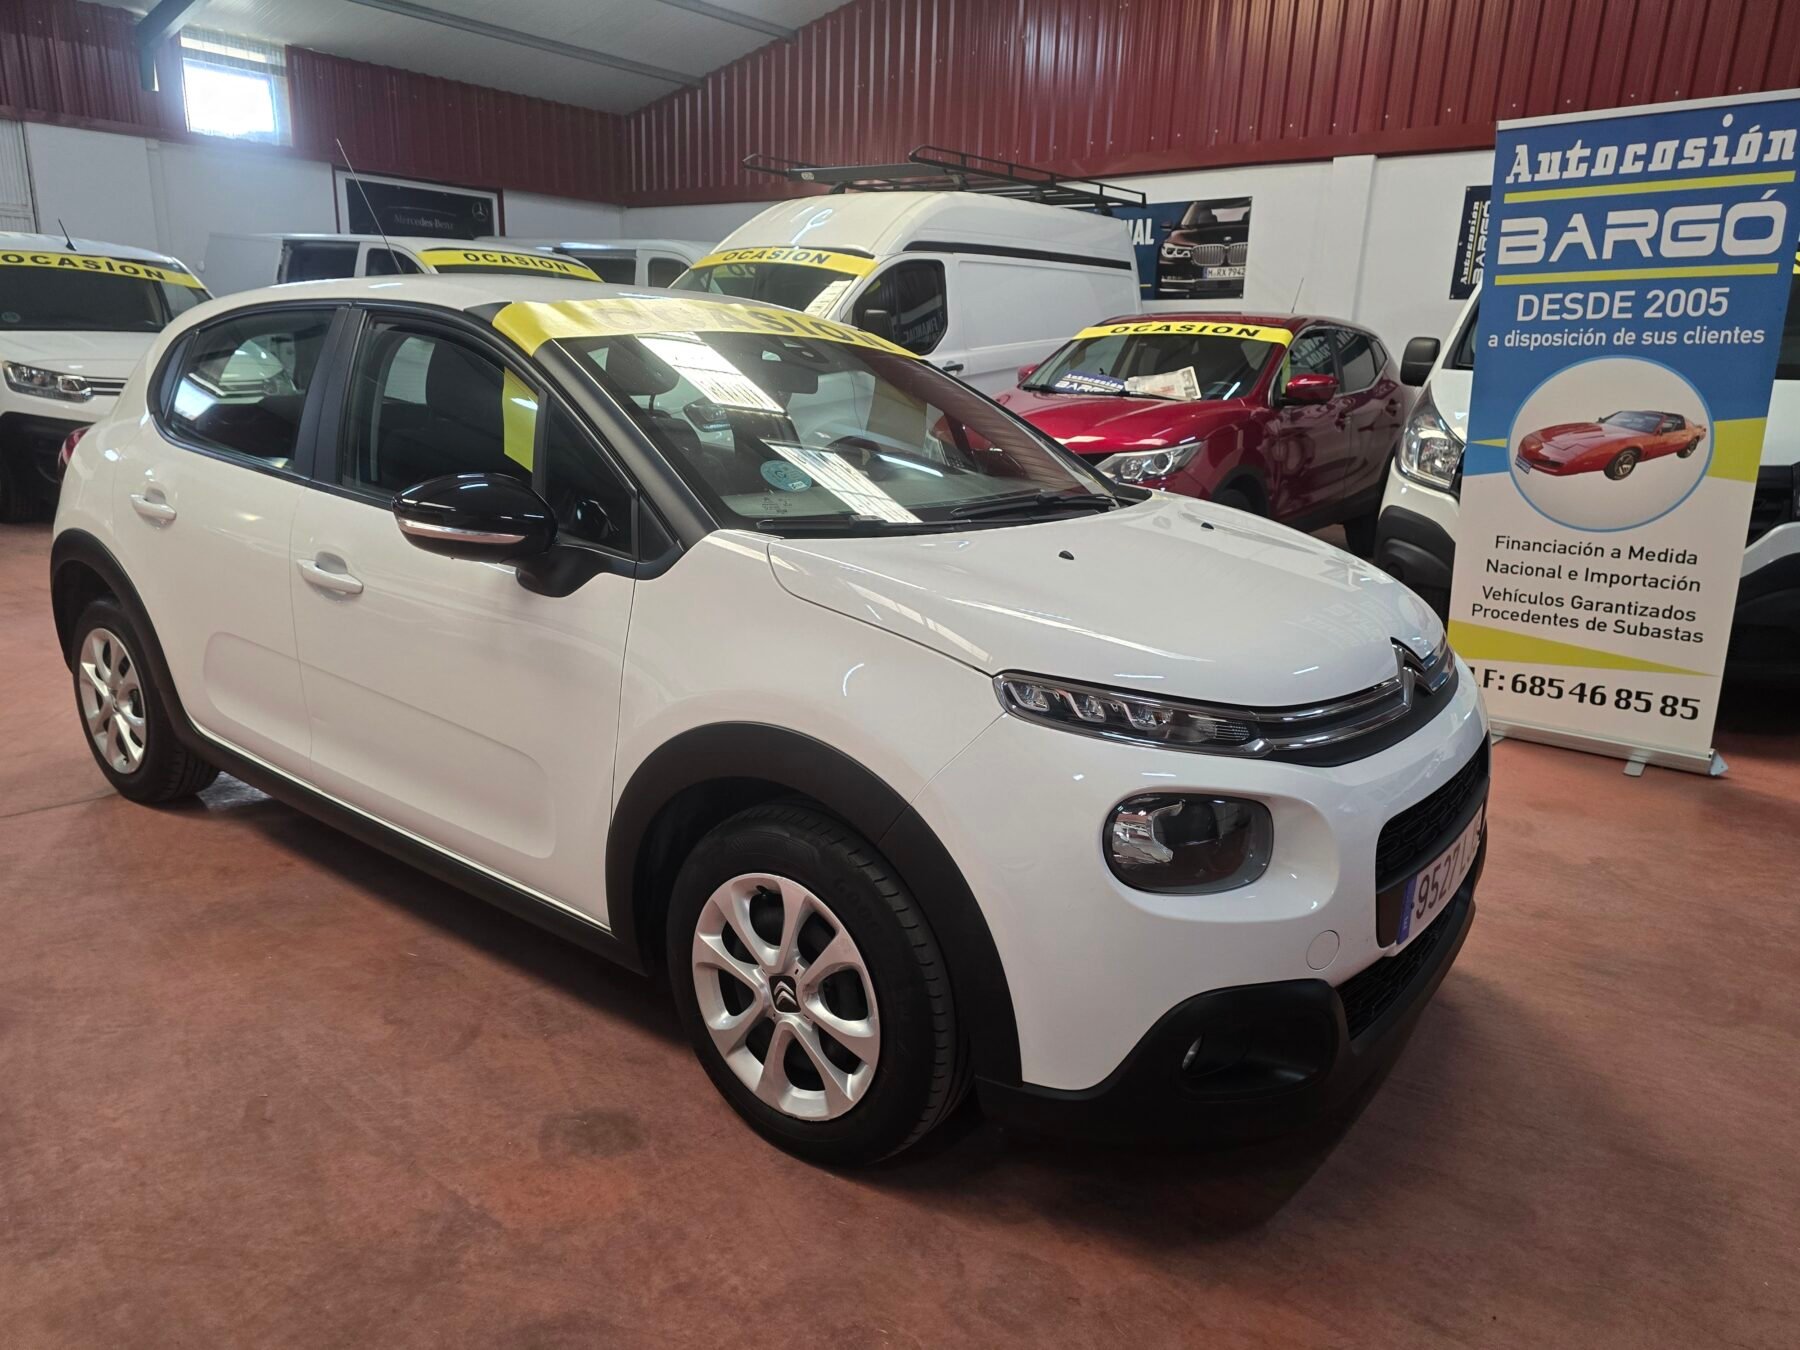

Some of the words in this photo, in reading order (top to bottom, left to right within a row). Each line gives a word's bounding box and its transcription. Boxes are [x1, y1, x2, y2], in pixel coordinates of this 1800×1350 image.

[1505, 113, 1797, 184] Autocasión
[1497, 189, 1787, 265] BARGÓ
[1, 254, 166, 280] OCASION
[463, 252, 570, 273] OCASION
[722, 249, 832, 265] OCASION
[1516, 290, 1636, 321] DESDE
[1644, 287, 1730, 318] 2005
[1110, 324, 1260, 337] OCASION
[1488, 334, 1498, 347] a
[1504, 328, 1606, 351] disposición
[1613, 328, 1636, 346] de
[1641, 331, 1677, 345] sus
[1683, 326, 1765, 345] clientes
[1495, 535, 1605, 557] Financiación
[1611, 548, 1621, 558] a
[1628, 545, 1698, 565] Medida
[1486, 559, 1562, 579] Nacional
[1568, 570, 1578, 580] e
[1584, 567, 1701, 592] Importación
[1482, 585, 1565, 607] Vehículos
[1570, 595, 1697, 622] Garantizados
[1471, 603, 1579, 628] Procedentes
[1585, 617, 1607, 632] de
[1613, 619, 1704, 643] Subastas
